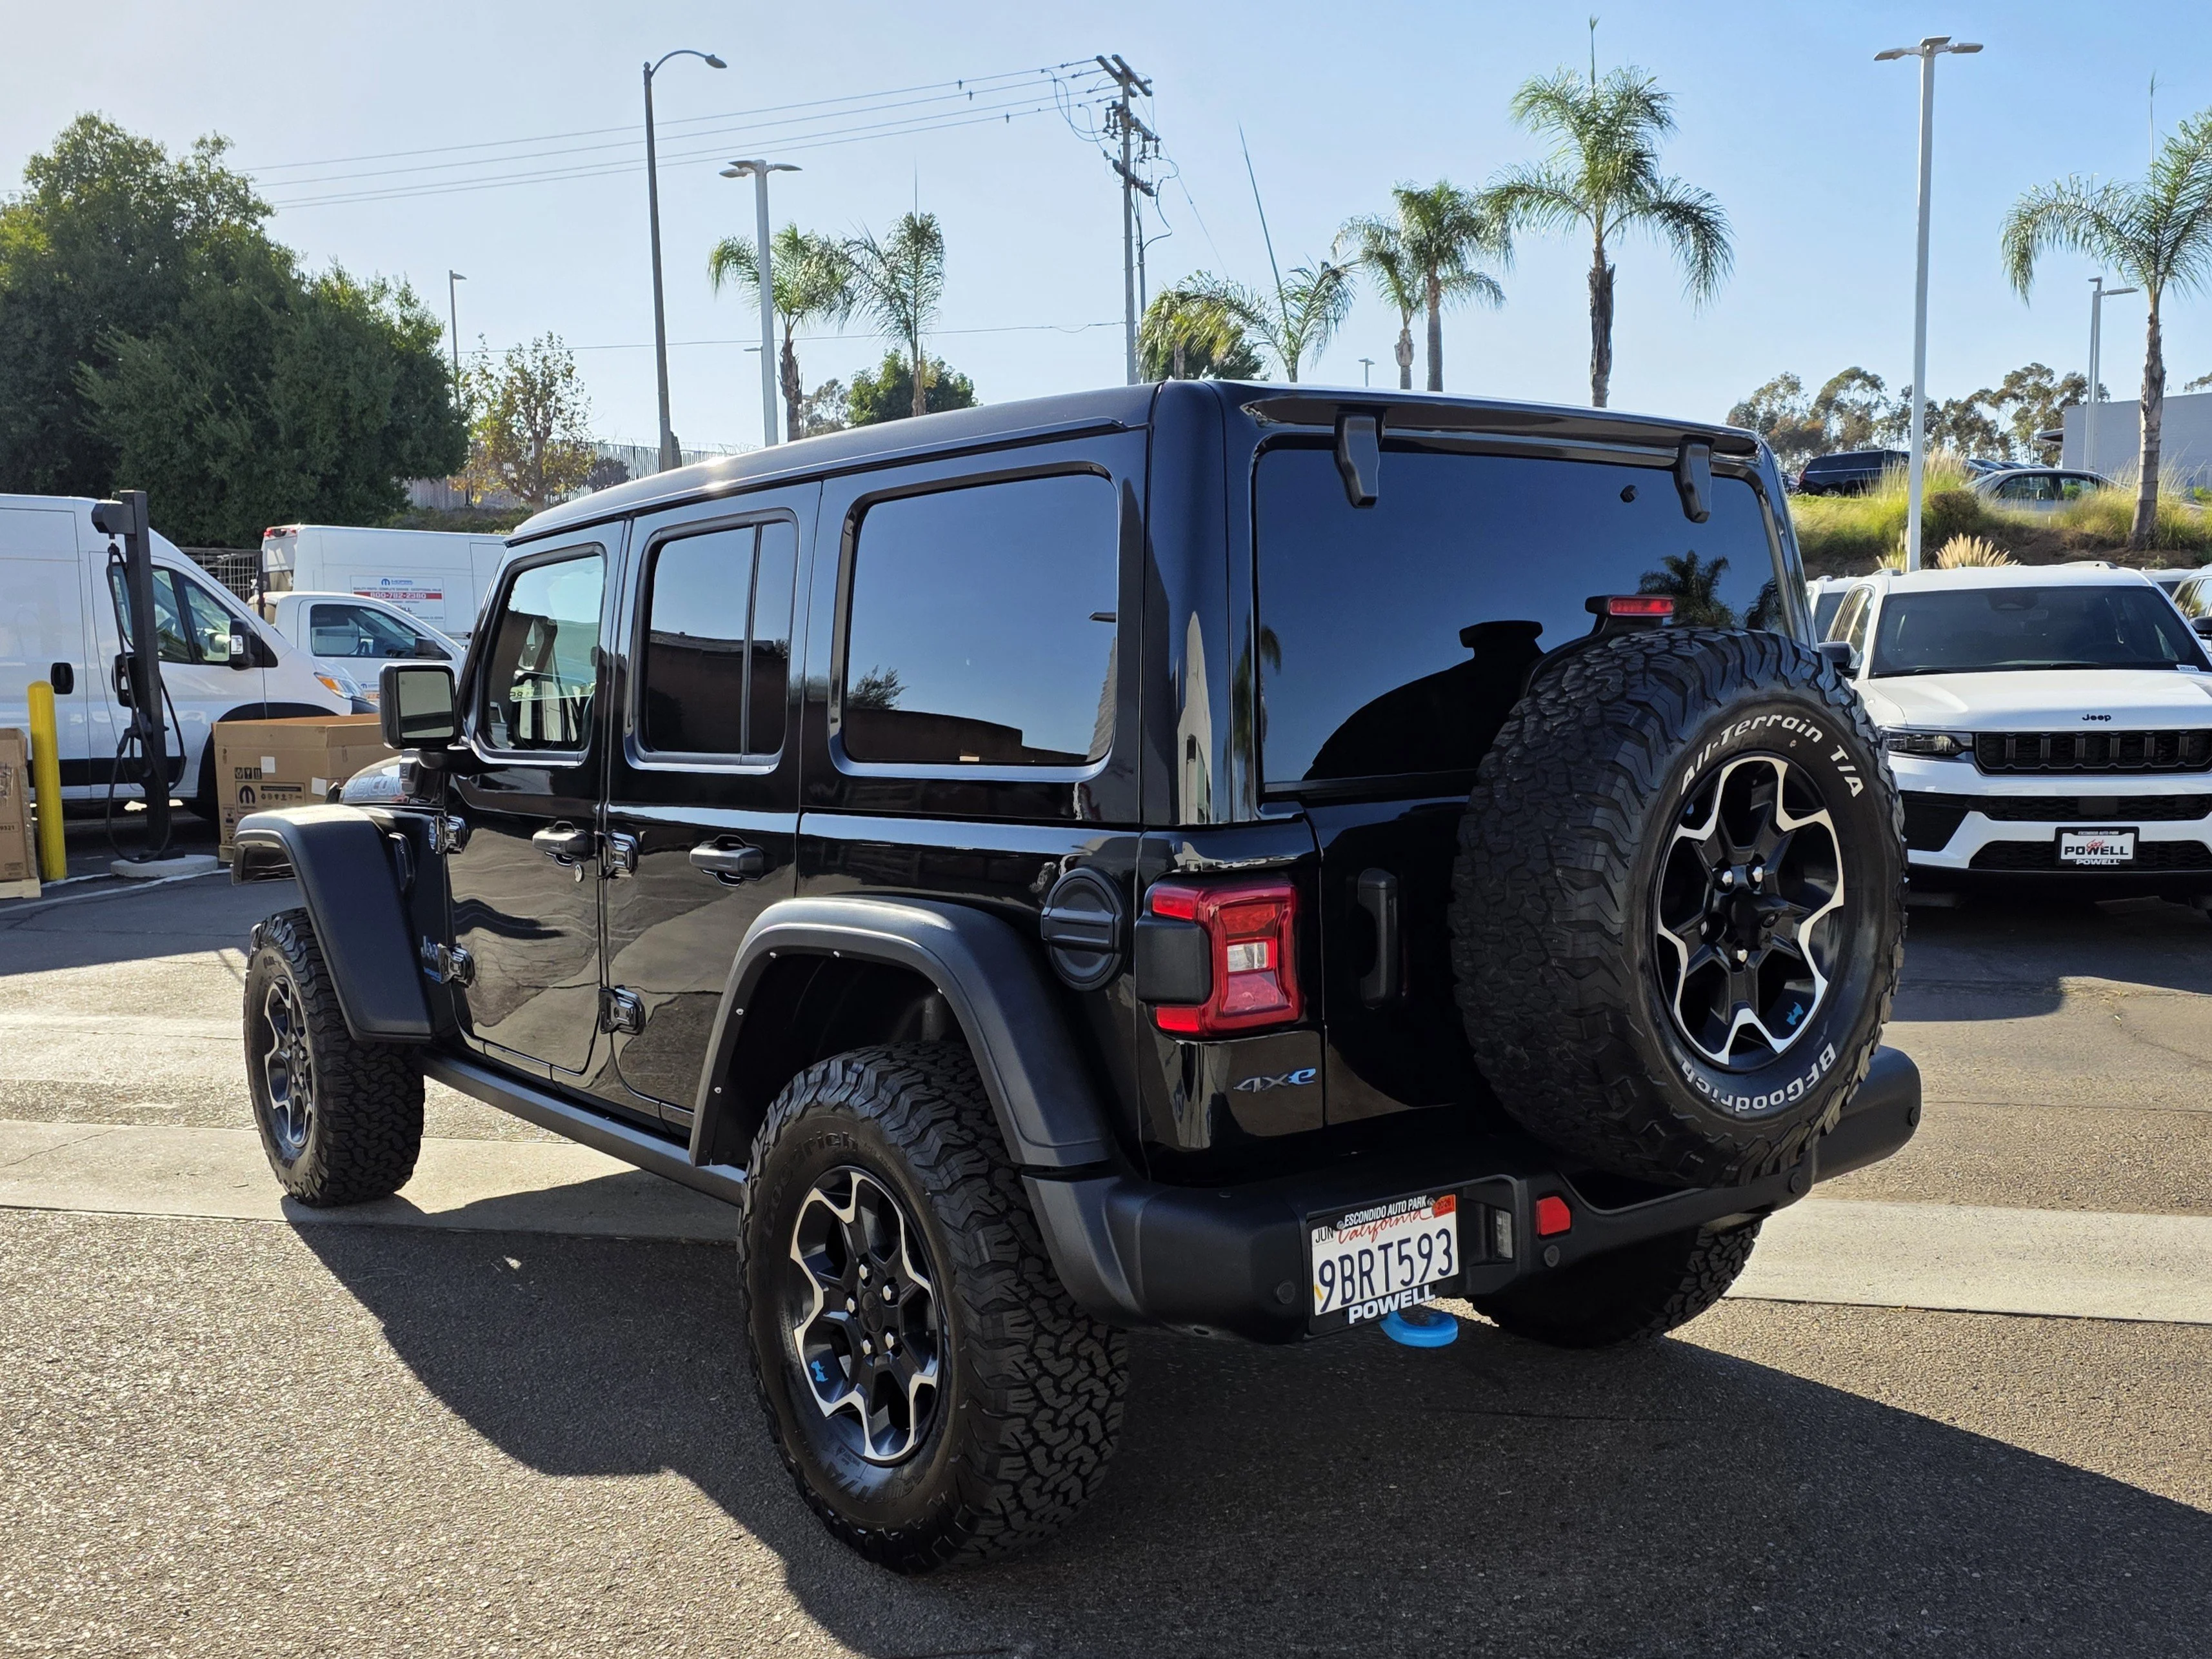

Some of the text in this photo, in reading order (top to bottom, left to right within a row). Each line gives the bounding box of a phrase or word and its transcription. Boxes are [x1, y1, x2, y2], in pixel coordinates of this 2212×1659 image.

[2082, 714, 2111, 722] Jeep
[1680, 714, 1864, 798] All-Terrain T/A
[2064, 846, 2129, 855] POWELL
[1681, 1042, 1837, 1112] BFGoodrich
[1344, 1195, 1427, 1226] ESCONDIDO AUTO PARK
[1315, 1225, 1334, 1243] JUN
[1319, 1228, 1452, 1313] 9BRT593
[1349, 1284, 1436, 1324] POWELL
